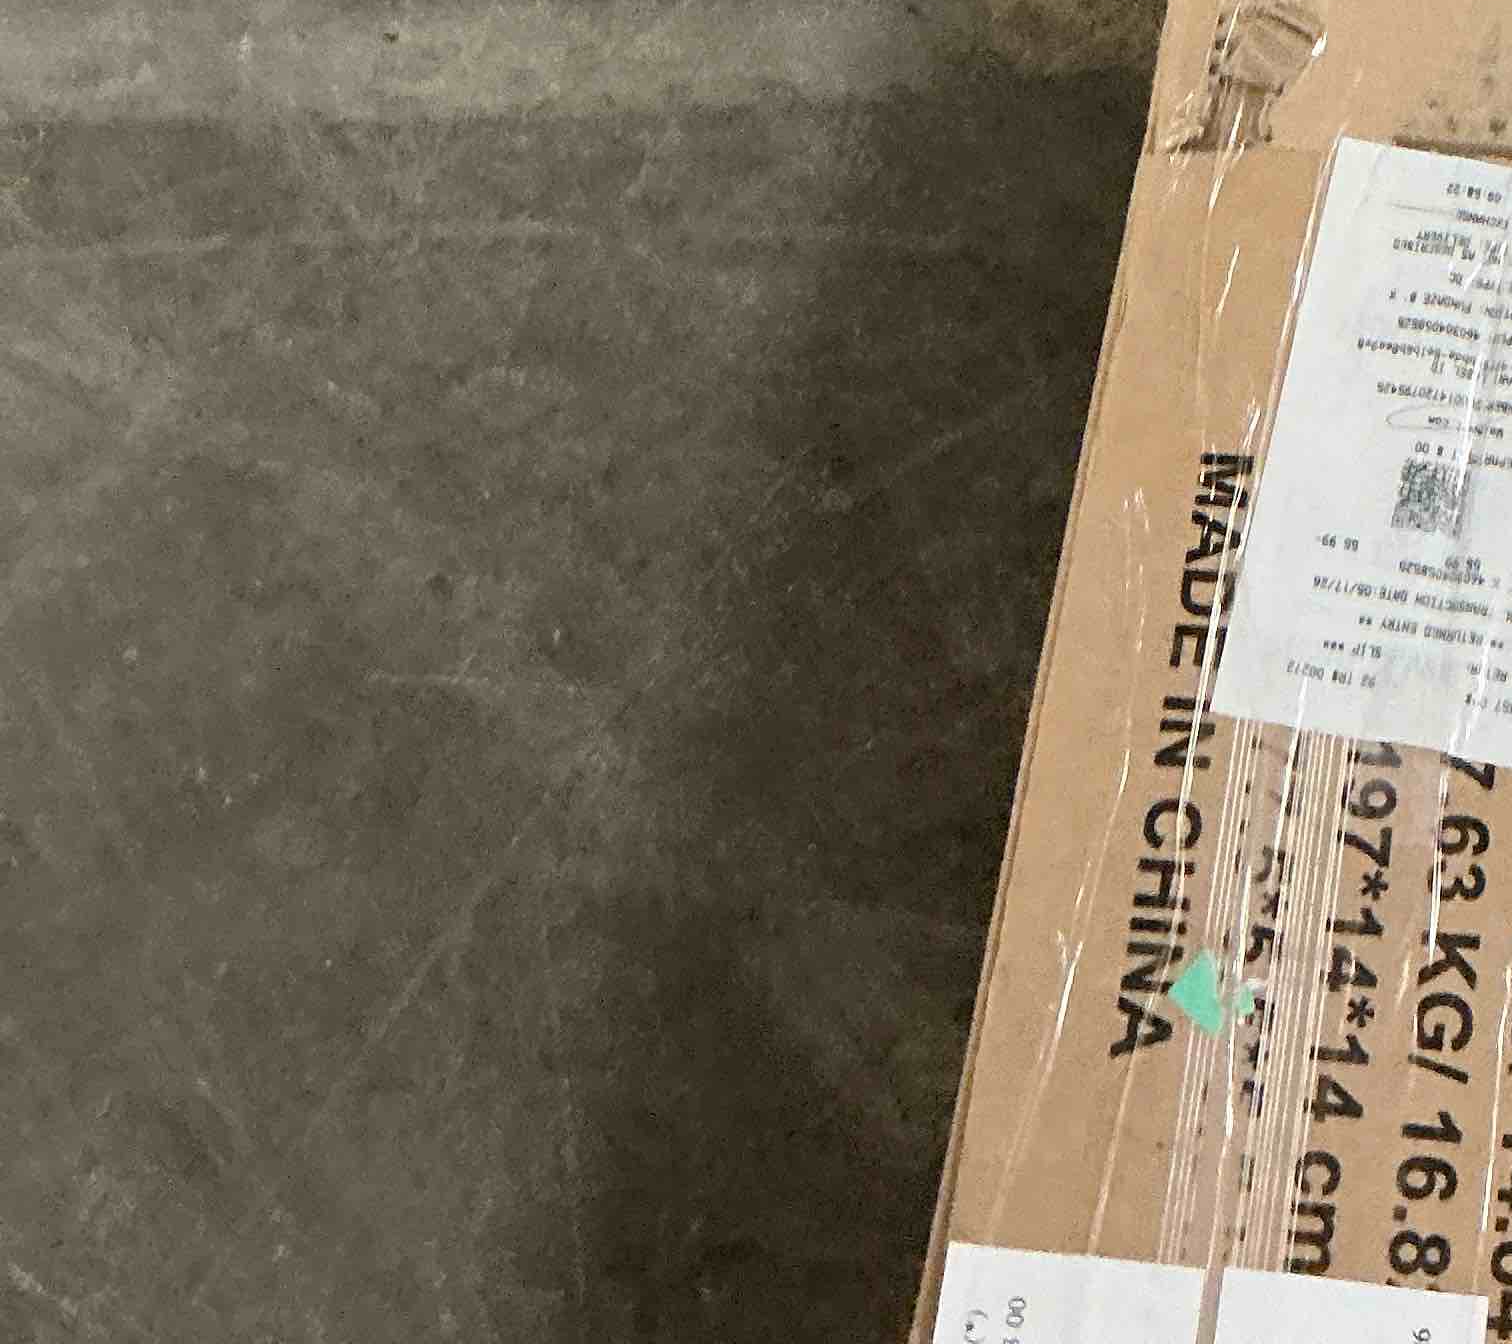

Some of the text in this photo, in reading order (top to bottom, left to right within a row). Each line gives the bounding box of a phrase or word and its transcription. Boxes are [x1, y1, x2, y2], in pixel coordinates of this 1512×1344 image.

[1109, 453, 1256, 1059] MADE IN CHINA
[1284, 1148, 1341, 1275] cm
[1386, 1110, 1464, 1292] 16.8
